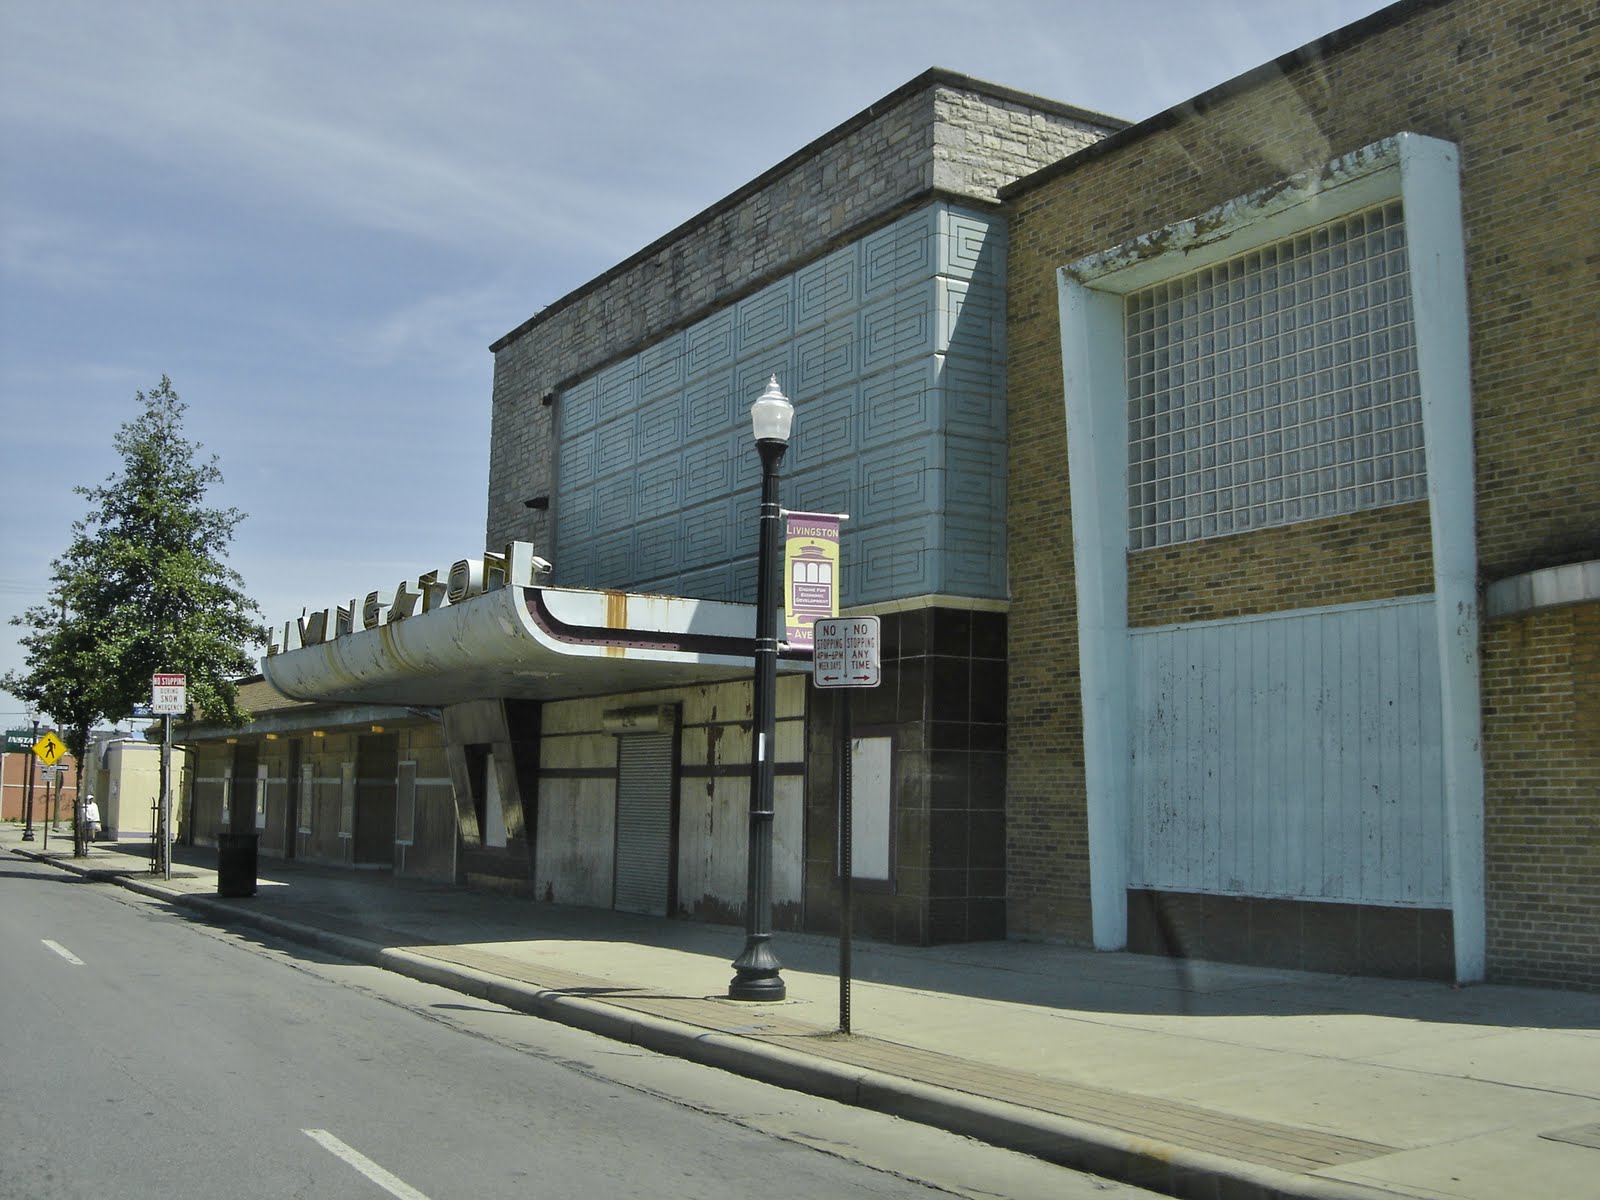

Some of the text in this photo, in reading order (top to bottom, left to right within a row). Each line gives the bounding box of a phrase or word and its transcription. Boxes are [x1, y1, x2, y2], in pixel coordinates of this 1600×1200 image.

[786, 524, 839, 537] LIVINGSTON
[823, 625, 836, 636] NO
[853, 624, 868, 635] NO
[817, 638, 843, 650] STOPPING
[846, 637, 875, 649] STOPPING
[852, 650, 870, 659] ANY
[851, 660, 870, 669] TIME
[154, 677, 185, 686] NO STOPPING
